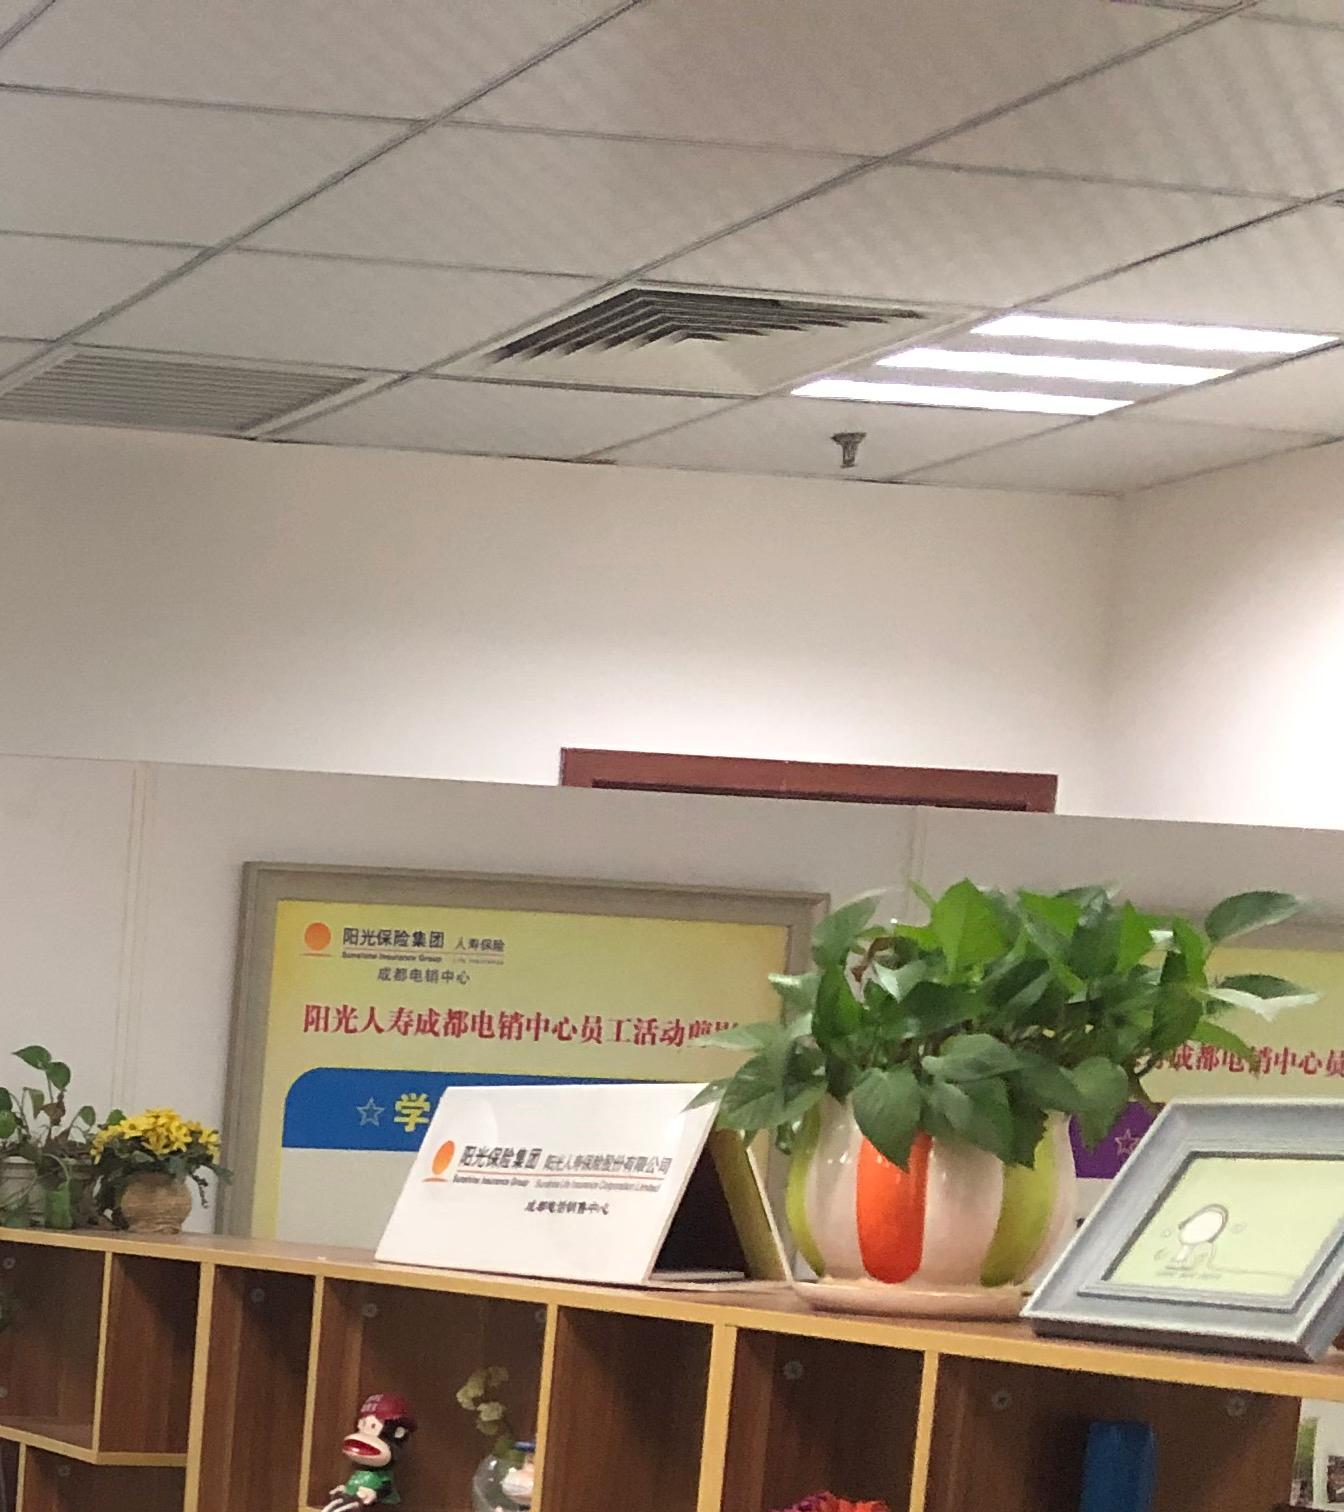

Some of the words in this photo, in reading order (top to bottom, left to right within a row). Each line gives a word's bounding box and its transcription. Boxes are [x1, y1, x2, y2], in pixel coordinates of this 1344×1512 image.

[343, 928, 445, 948] 阳光保险集团
[454, 936, 505, 953] 人寿保险
[377, 967, 470, 985] 成都电销中心
[393, 1092, 431, 1132] 学
[461, 1145, 543, 1169] 阳光保险集团
